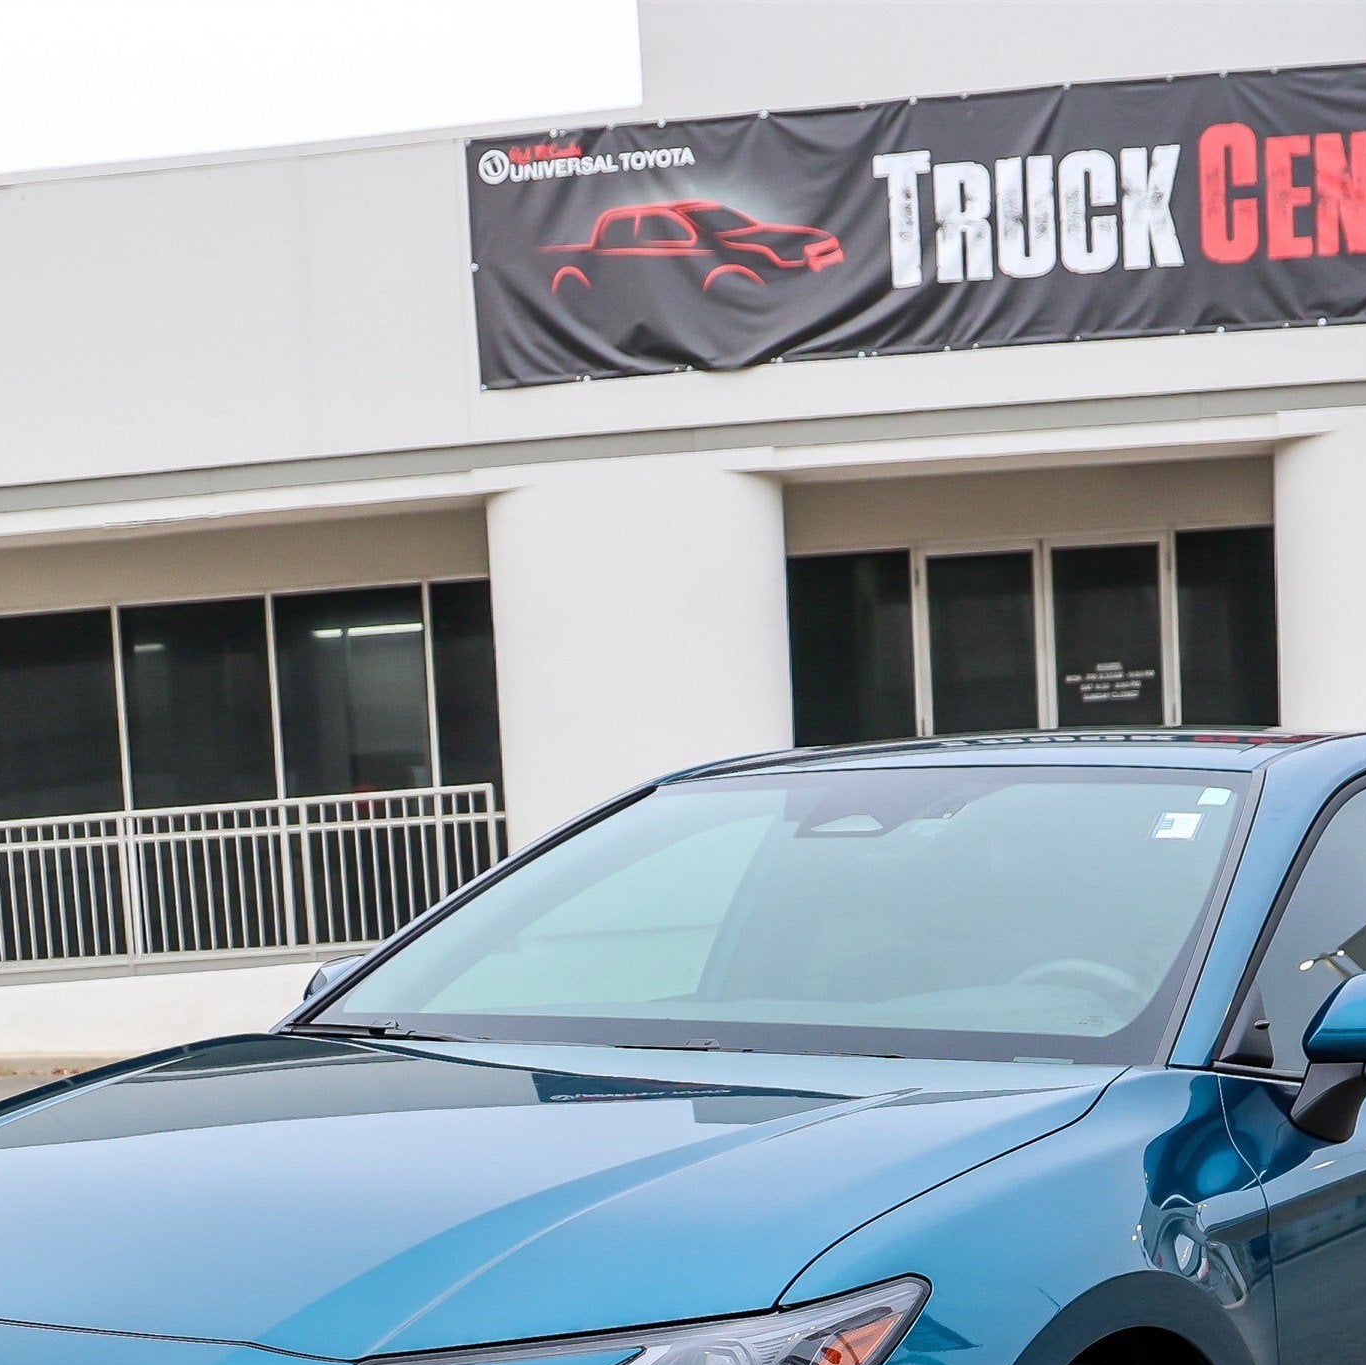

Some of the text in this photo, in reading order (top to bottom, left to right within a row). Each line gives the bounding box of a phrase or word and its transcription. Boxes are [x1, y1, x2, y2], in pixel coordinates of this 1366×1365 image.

[510, 154, 619, 182] UNIVERSAL
[619, 146, 696, 171] TOYOTA
[871, 142, 1185, 289] TRUCK
